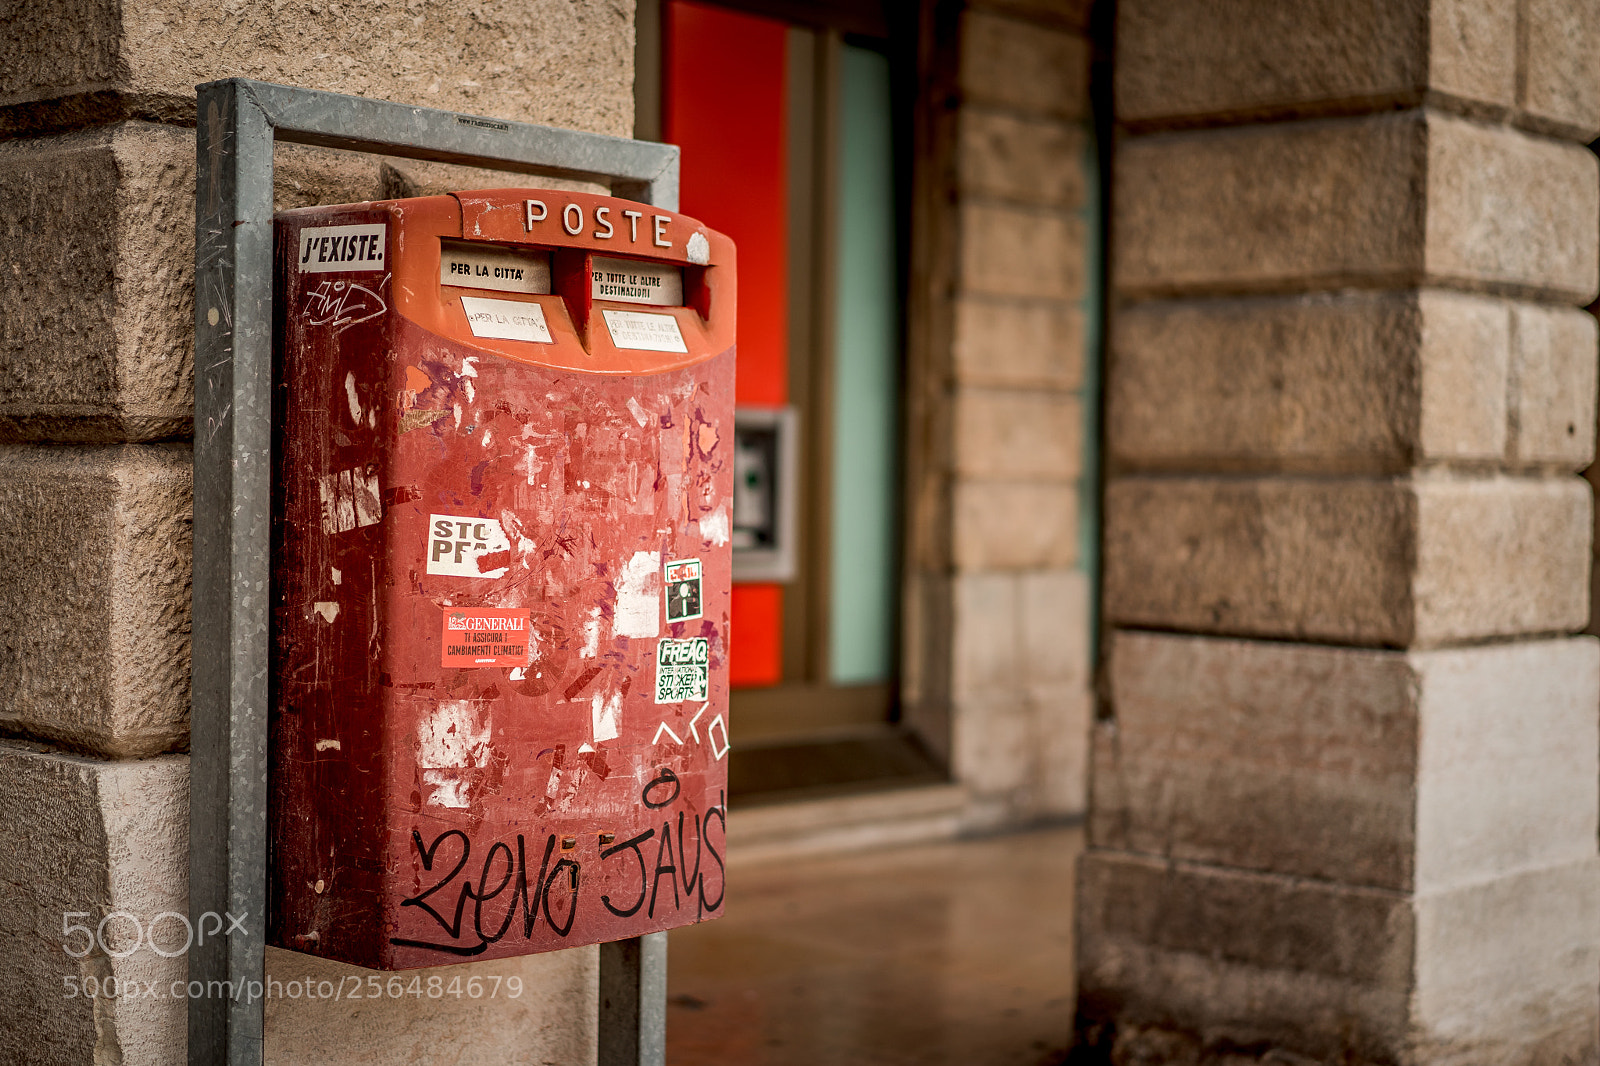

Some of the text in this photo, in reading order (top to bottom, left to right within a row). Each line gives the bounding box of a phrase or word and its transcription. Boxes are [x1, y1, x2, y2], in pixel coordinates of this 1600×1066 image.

[525, 200, 673, 248] POSTE
[302, 234, 383, 263] J'EXISTE.
[451, 262, 471, 276] PER
[476, 265, 489, 278] LA
[630, 275, 637, 285] LE
[640, 276, 661, 287] ALTRE
[600, 285, 650, 298] DESTINAZIONI
[474, 312, 493, 323] PER
[495, 314, 509, 325] LA
[434, 520, 491, 541] STO
[466, 618, 524, 631] GENERALI
[465, 633, 470, 643] TI
[473, 633, 503, 643] ASSICURA
[447, 645, 491, 656] CAMBIAMENTI
[661, 641, 707, 663] FREAQ
